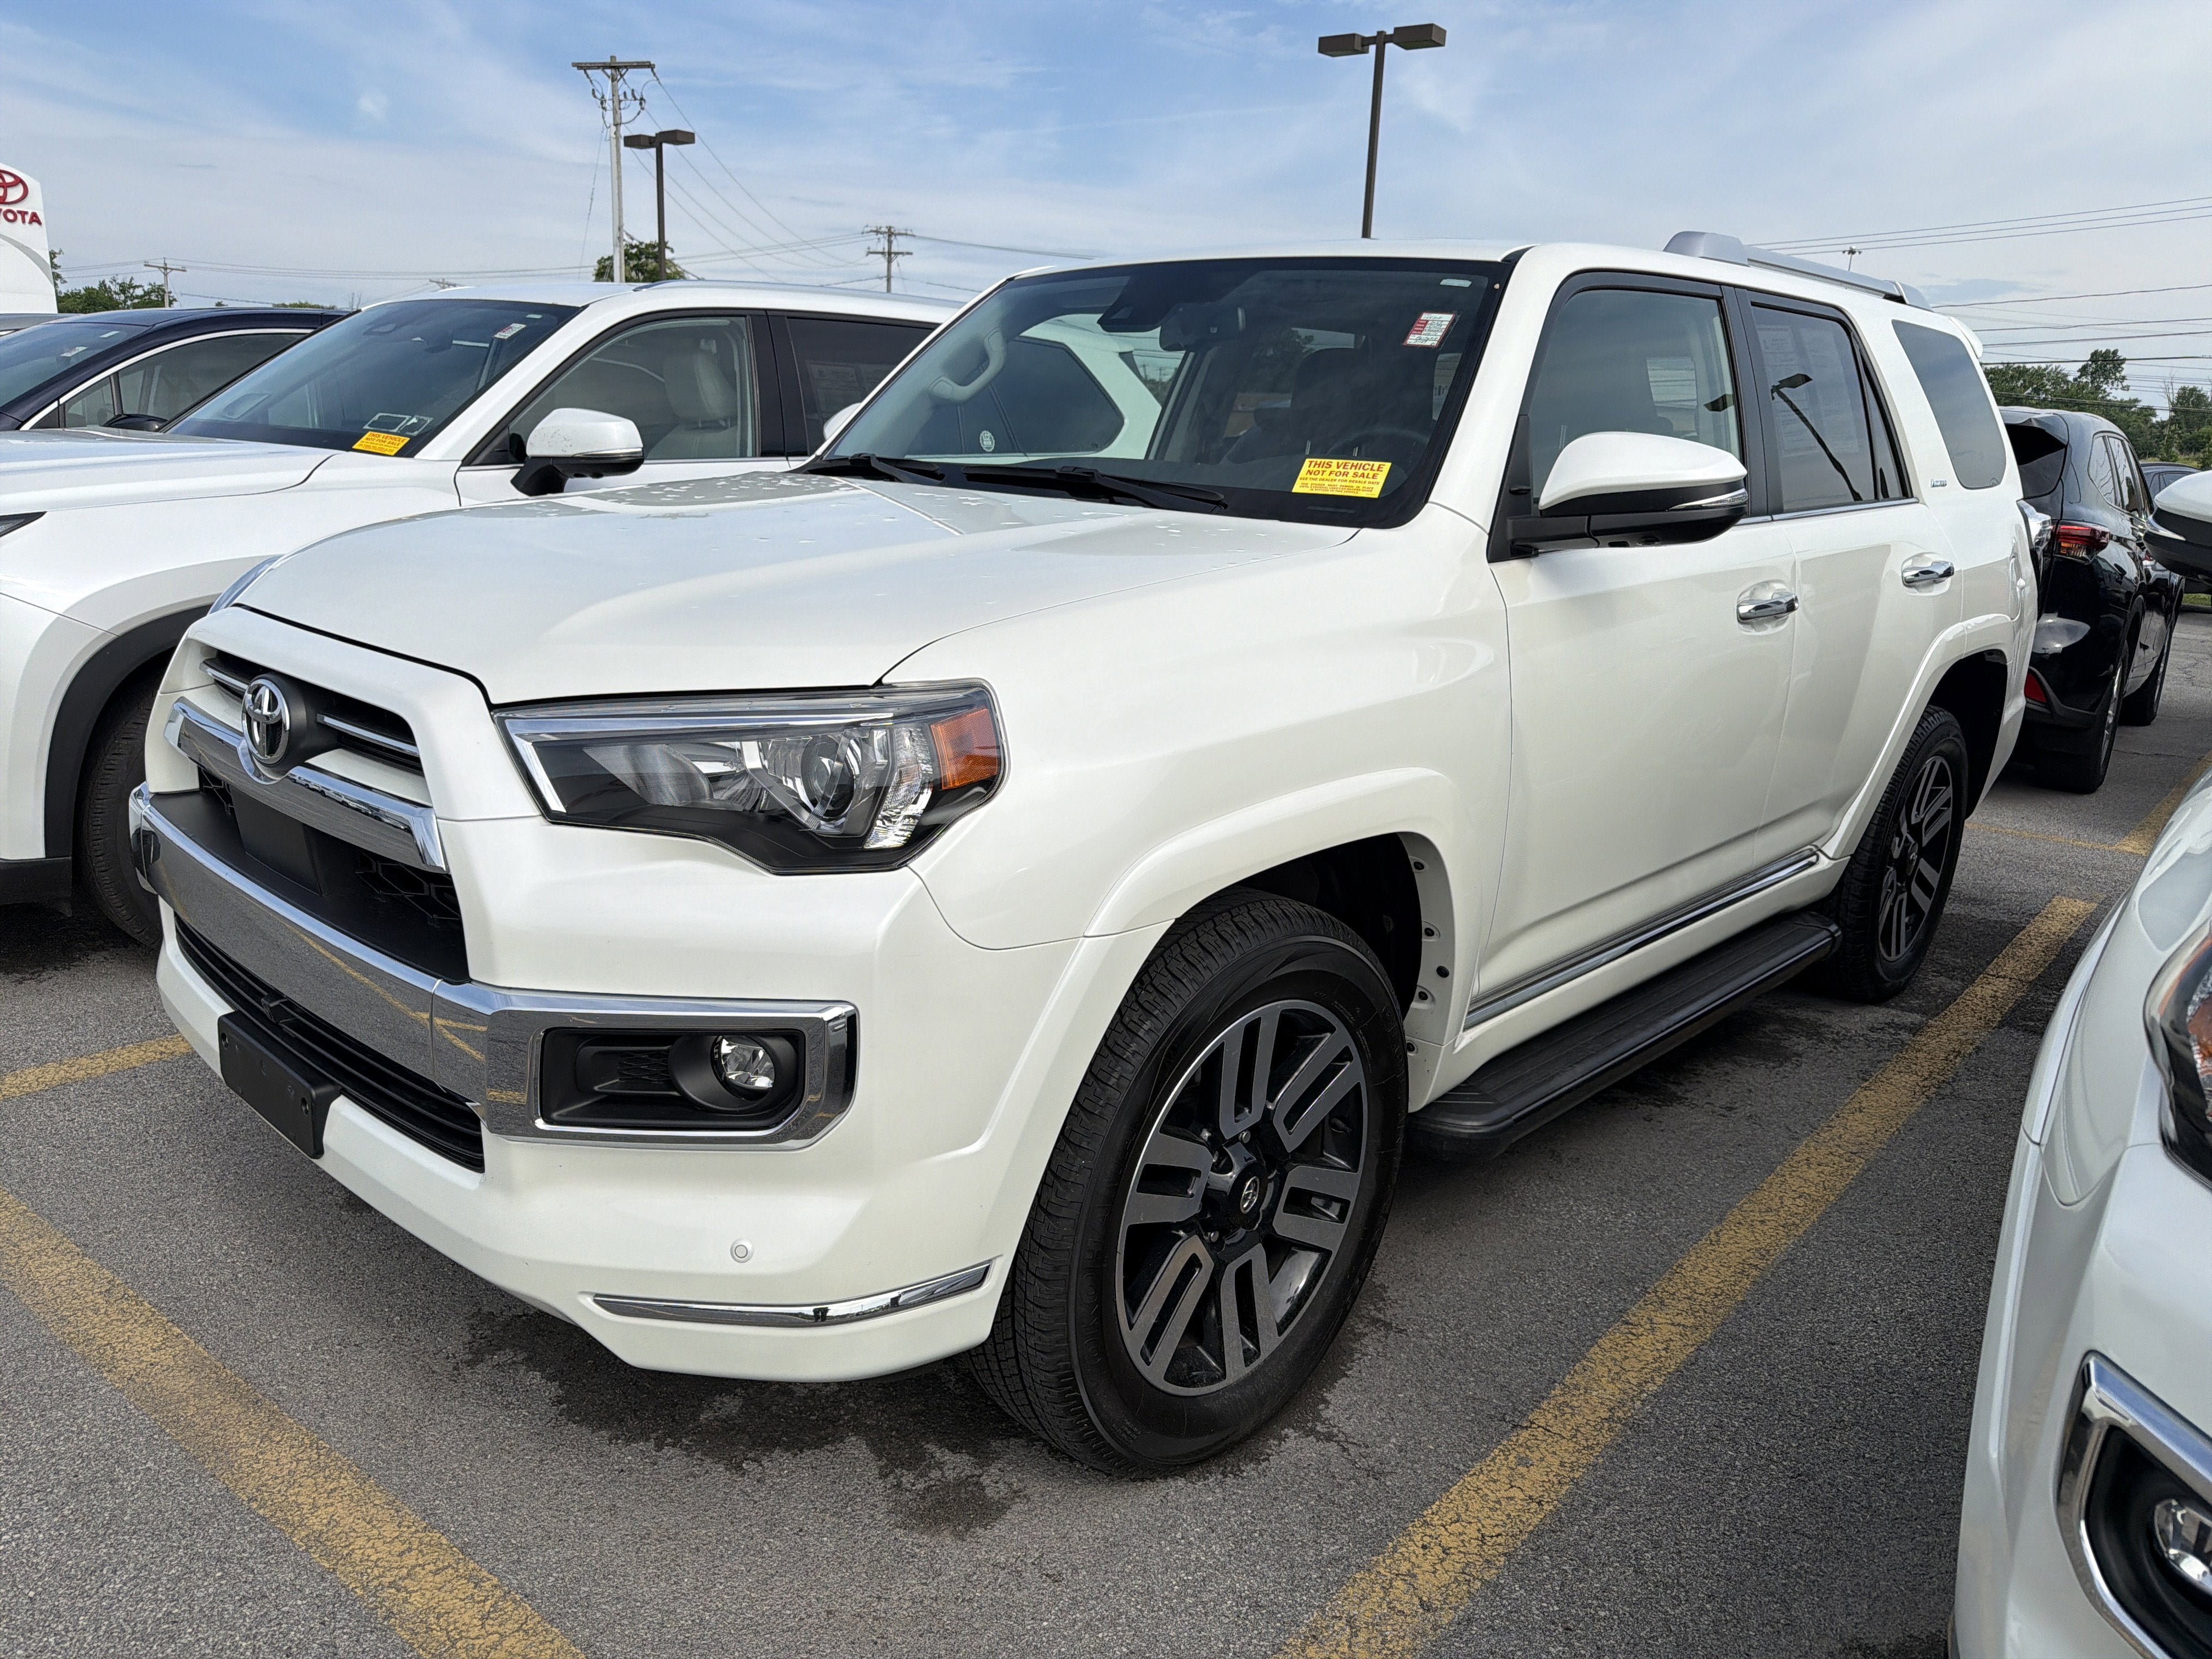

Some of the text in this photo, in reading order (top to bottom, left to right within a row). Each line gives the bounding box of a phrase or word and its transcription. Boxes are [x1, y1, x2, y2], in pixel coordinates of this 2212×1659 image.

[0, 208, 42, 225] OTA
[1308, 460, 1385, 472] THIS VEHICLE
[1351, 471, 1379, 479] SALE
